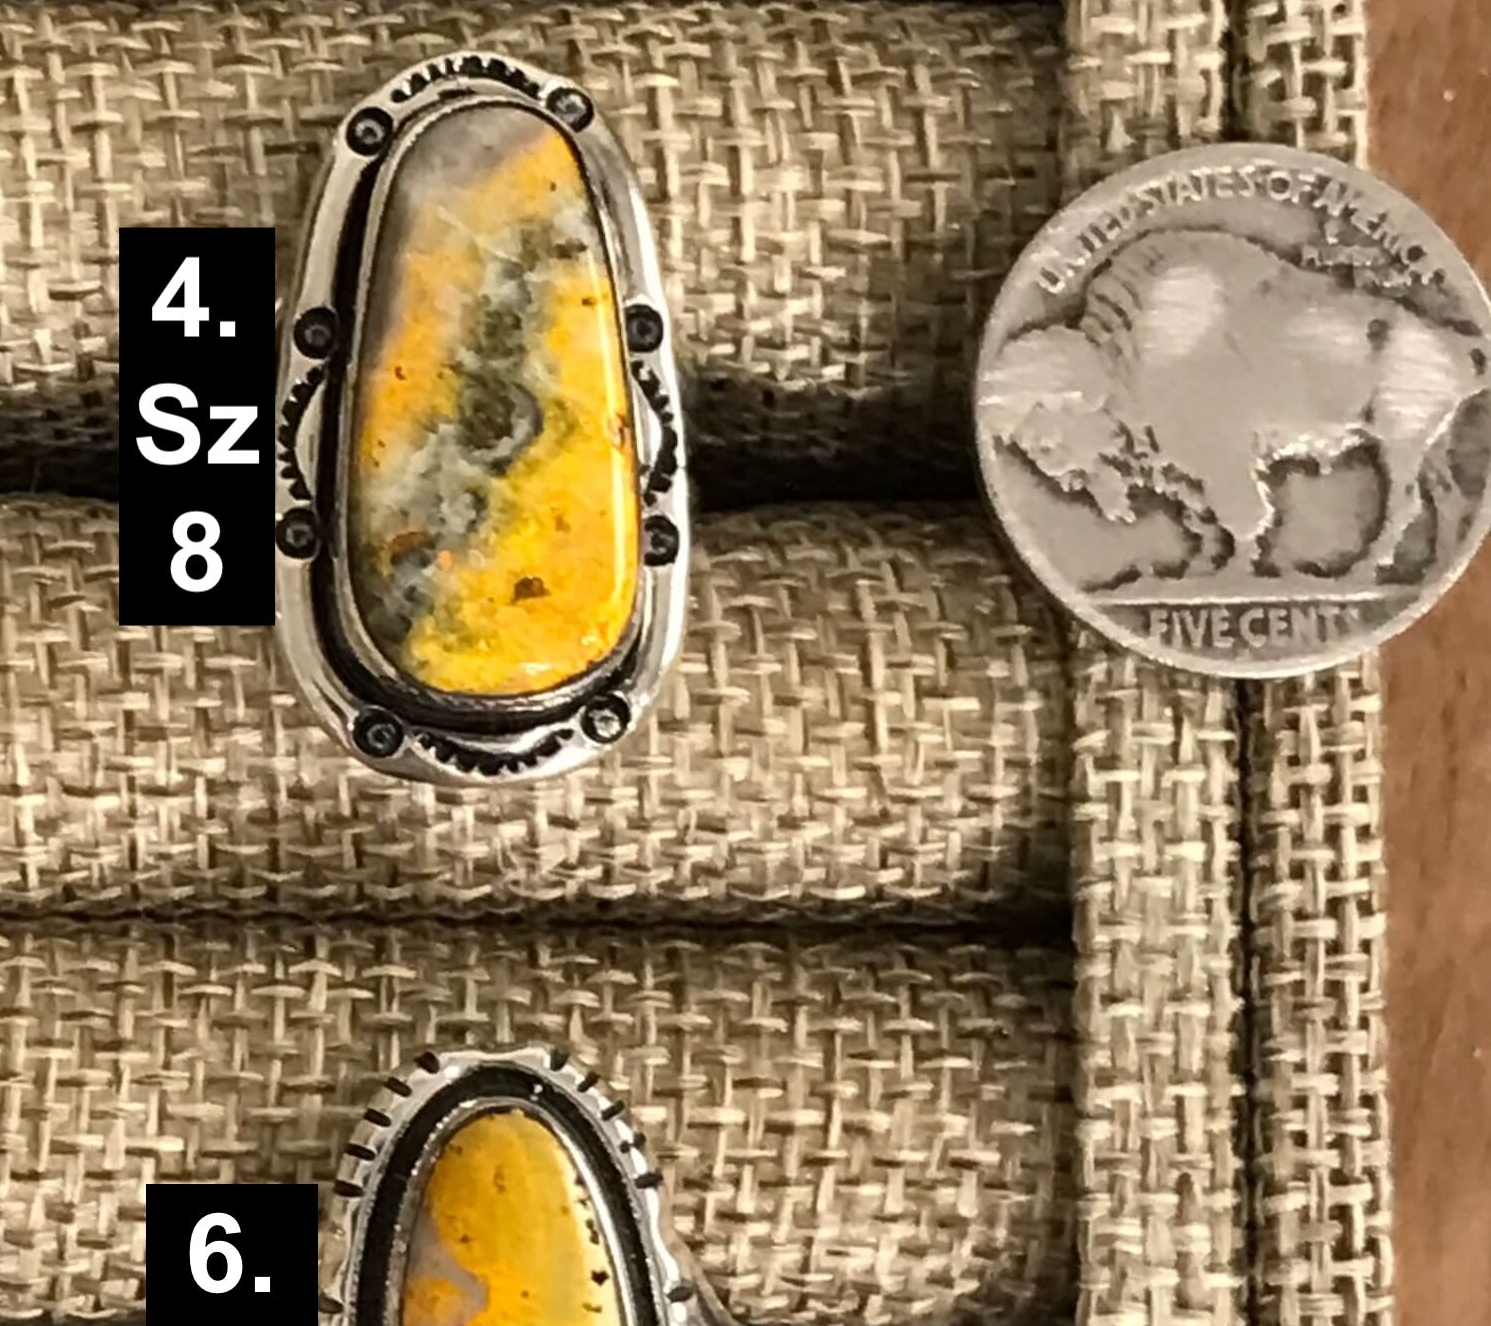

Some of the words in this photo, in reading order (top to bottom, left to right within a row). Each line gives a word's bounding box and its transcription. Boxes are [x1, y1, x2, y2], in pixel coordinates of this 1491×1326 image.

[1127, 164, 1255, 216] STATES
[1266, 169, 1316, 204] OF
[1150, 607, 1235, 649] FIVE
